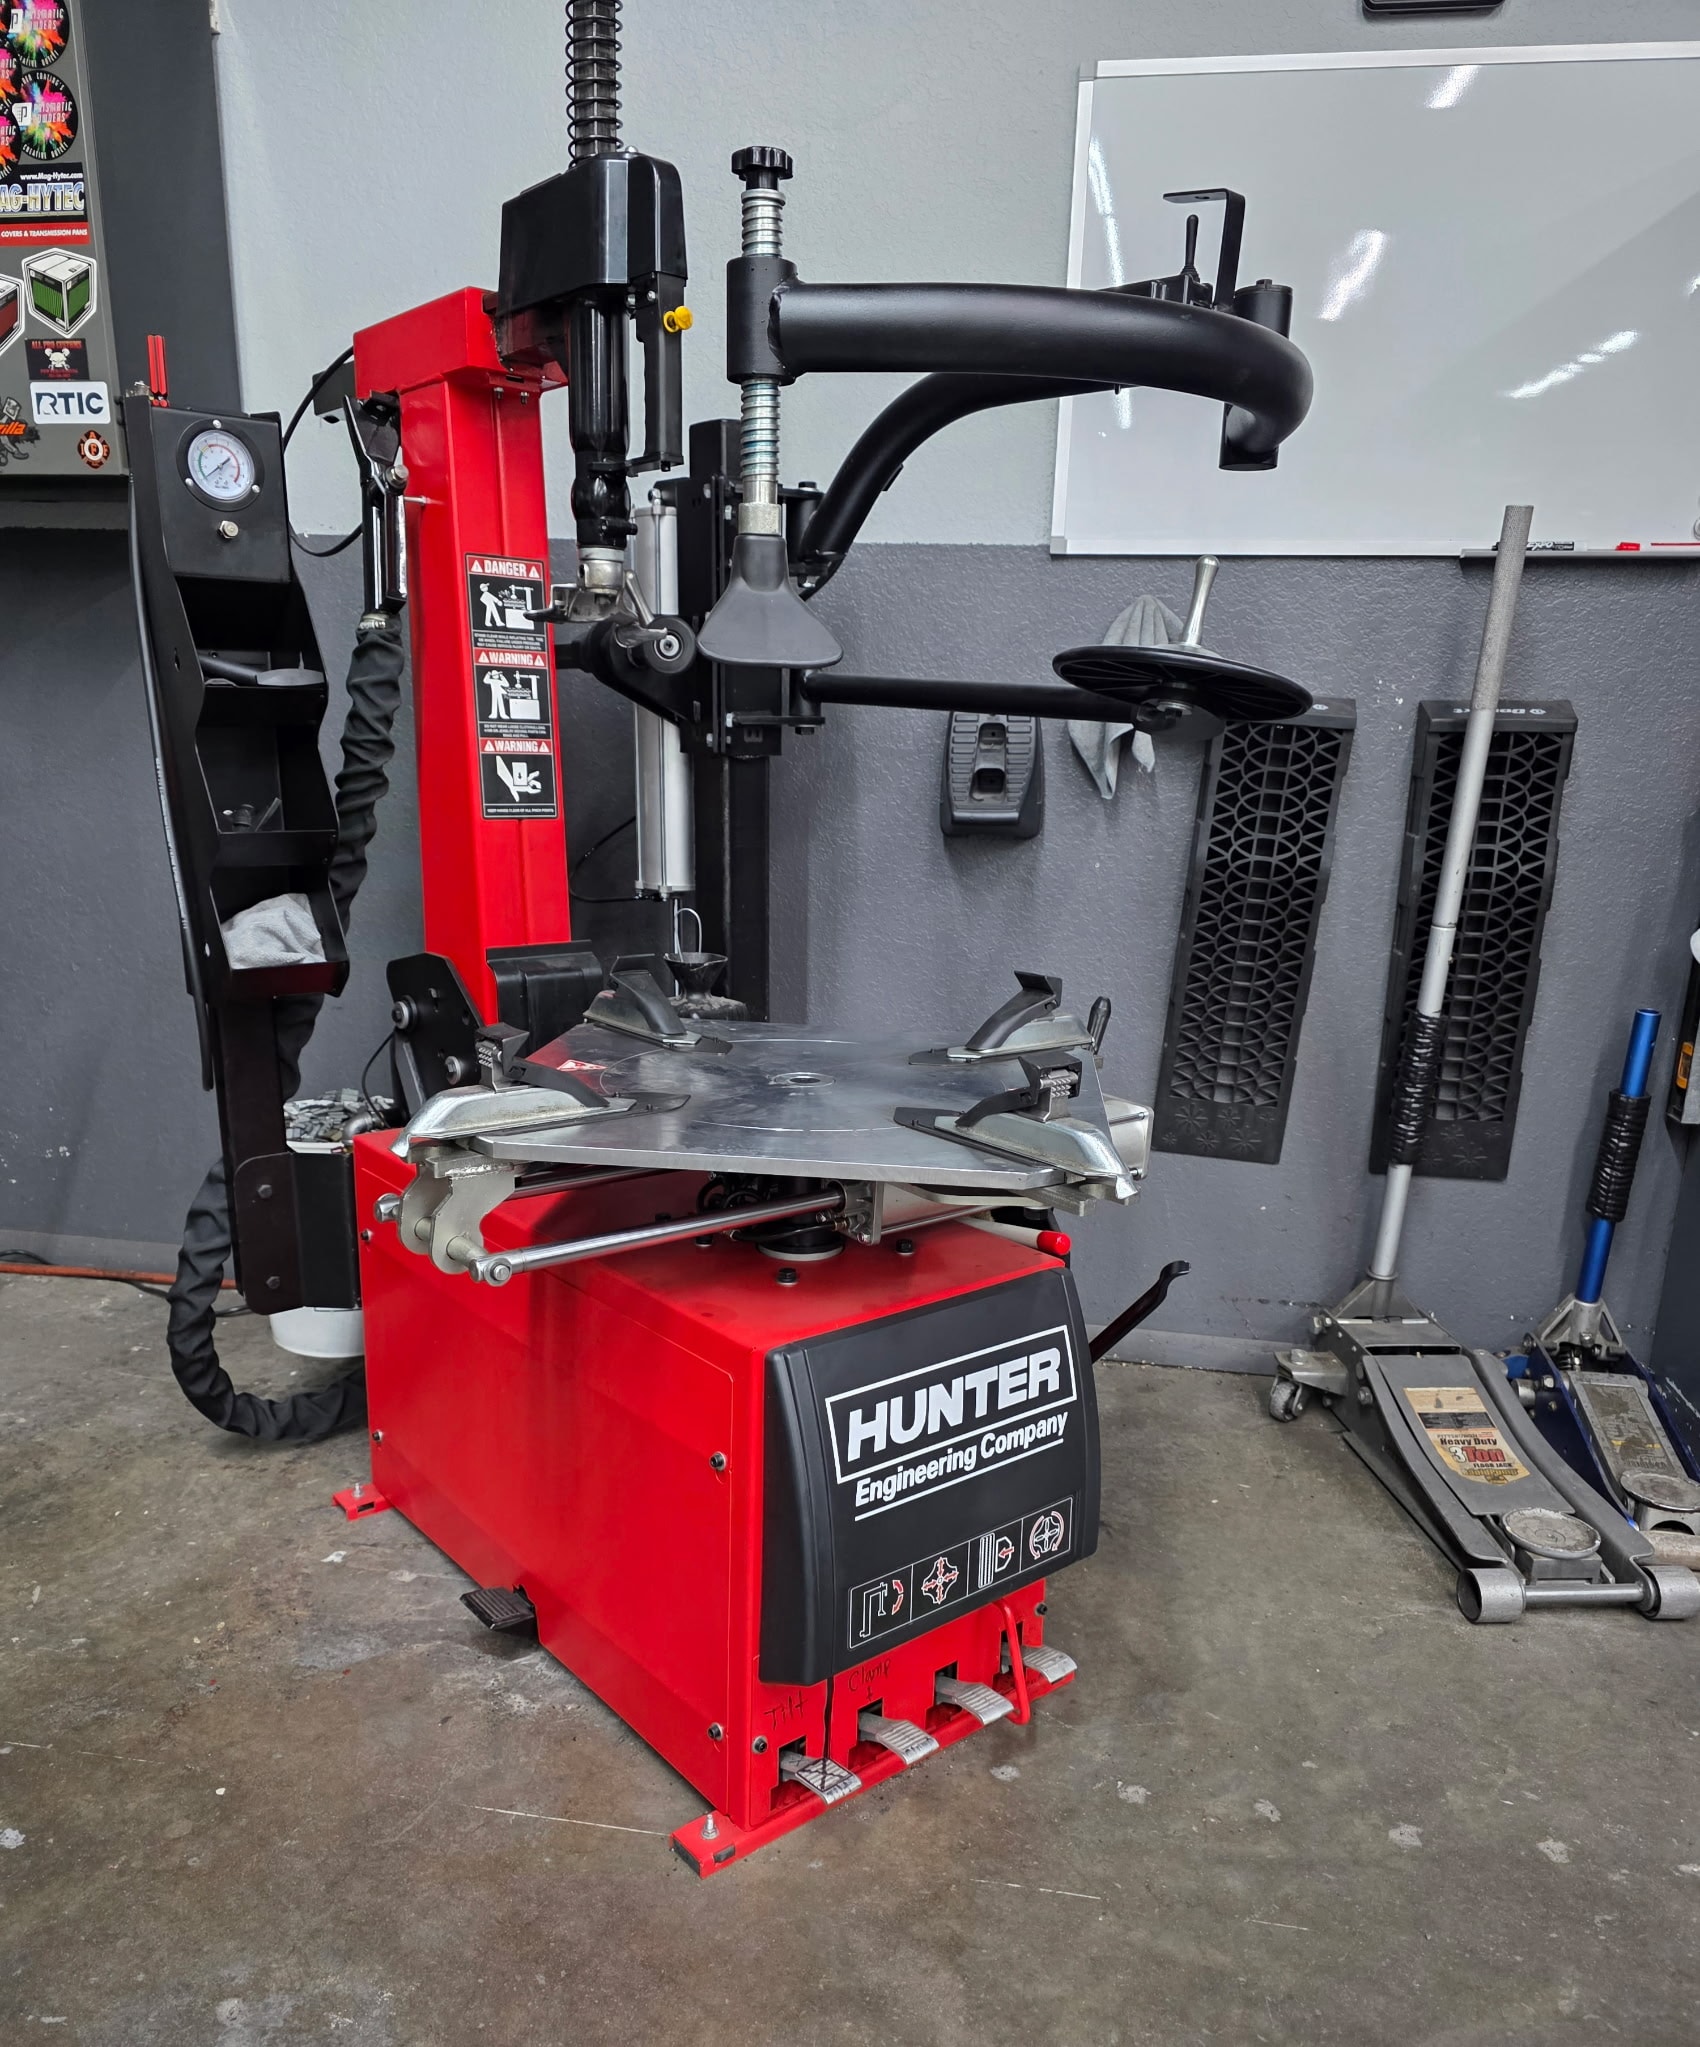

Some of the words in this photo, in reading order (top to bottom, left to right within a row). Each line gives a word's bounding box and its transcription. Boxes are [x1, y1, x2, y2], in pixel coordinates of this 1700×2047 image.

[25, 9, 65, 20] ISMATIC
[29, 229, 71, 237] TRANSMISSION
[35, 391, 104, 415] RTIC
[483, 559, 528, 578] DANGER
[488, 651, 534, 666] WARNING
[494, 740, 539, 752] WARNING
[847, 1346, 1062, 1463] HUNTER
[1440, 1438, 1472, 1446] Heavy
[1474, 1437, 1498, 1446] Duty
[855, 1443, 978, 1508] Engineering
[979, 1411, 1069, 1459] Company
[764, 1690, 809, 1731] Tilt
